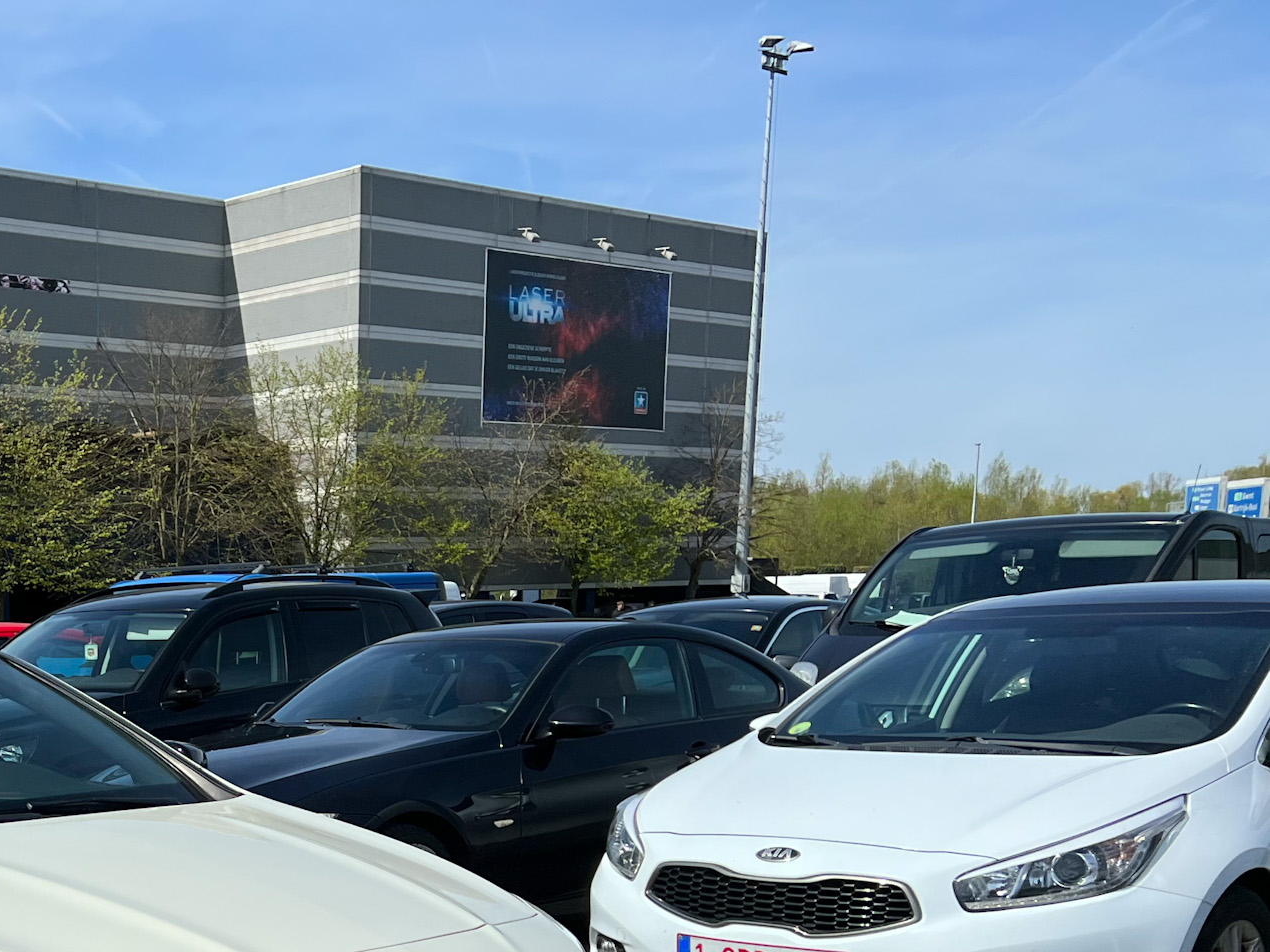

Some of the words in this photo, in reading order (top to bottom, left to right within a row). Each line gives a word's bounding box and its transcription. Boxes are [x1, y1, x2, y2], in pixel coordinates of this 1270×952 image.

[509, 284, 566, 305] LASER
[509, 299, 565, 325] ULTRA
[762, 848, 792, 859] KIA
